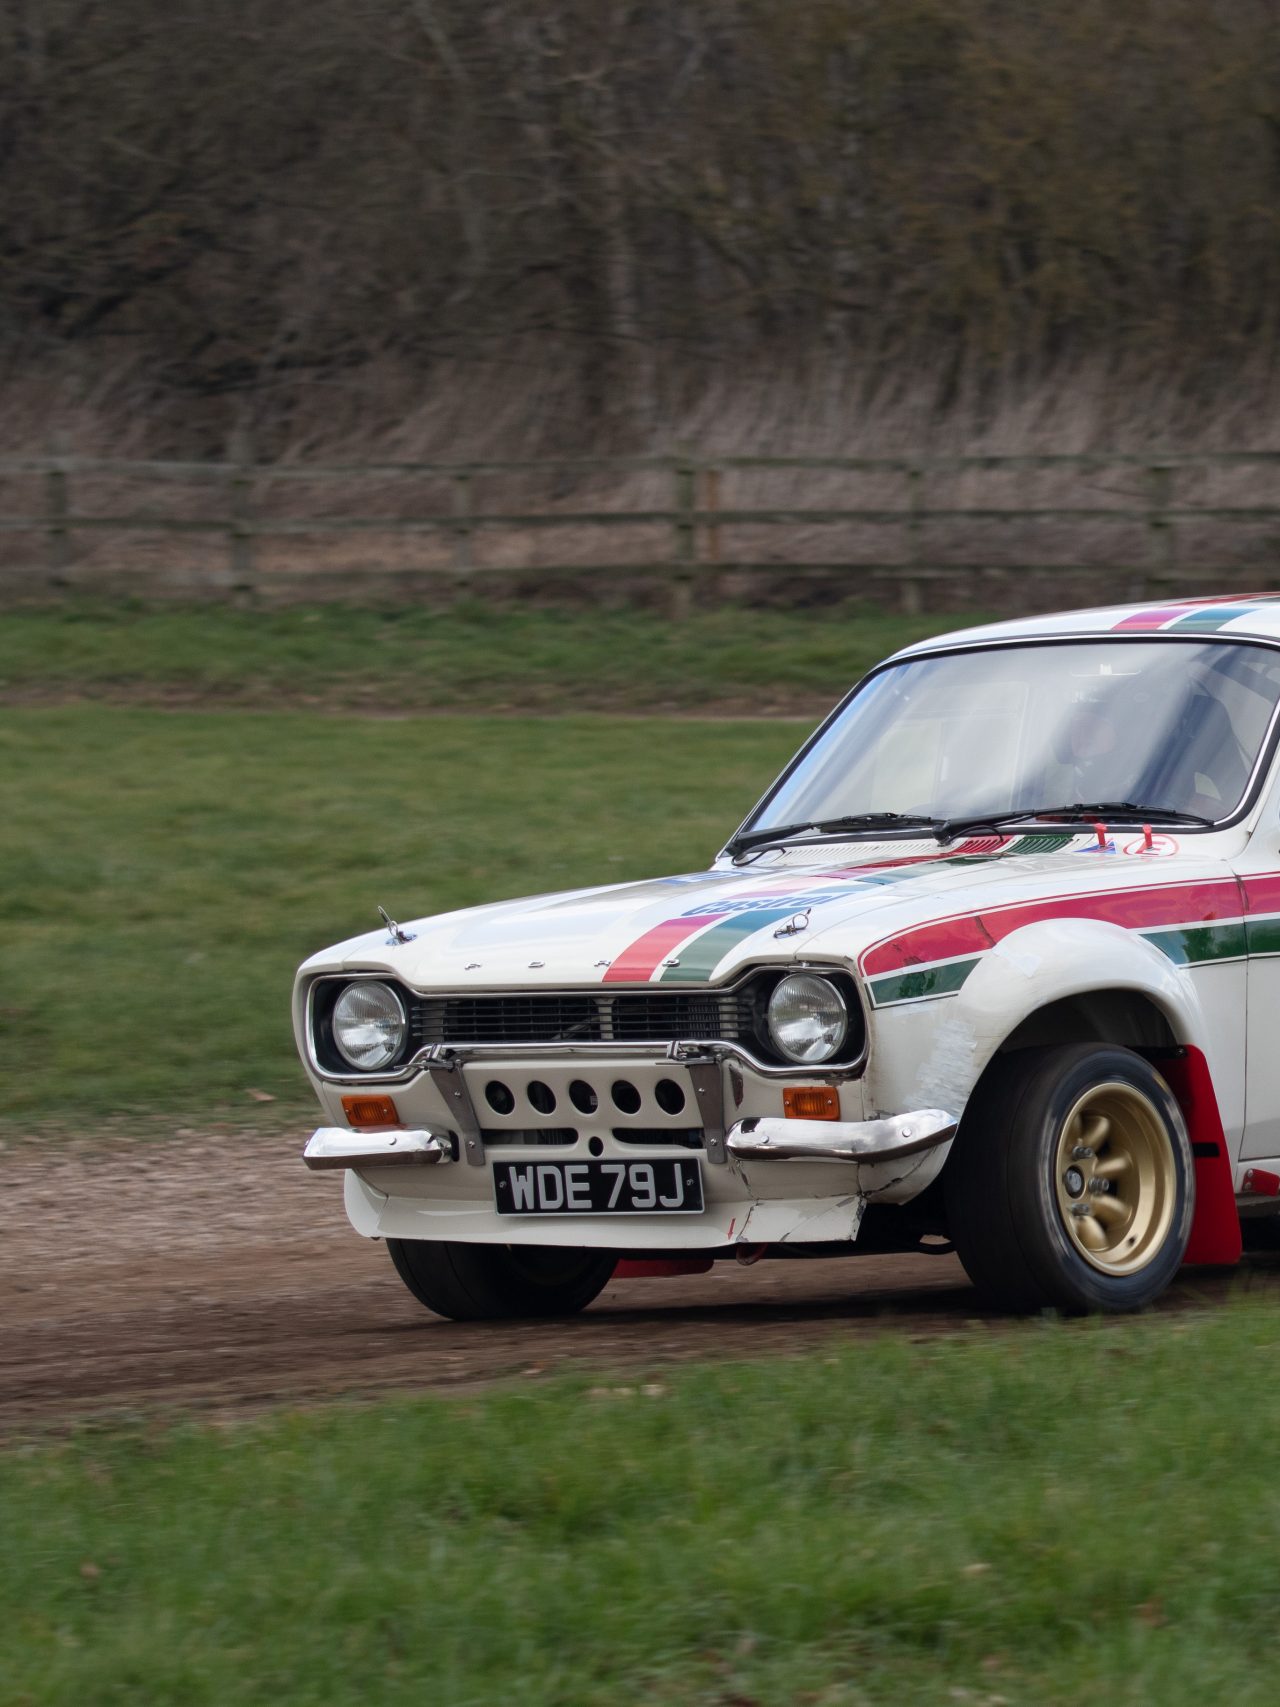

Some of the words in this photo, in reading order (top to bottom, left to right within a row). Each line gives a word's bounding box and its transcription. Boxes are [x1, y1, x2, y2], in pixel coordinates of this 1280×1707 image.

[681, 892, 856, 916] Castrol
[508, 1164, 593, 1210] WDE
[600, 1163, 685, 1209] 79J
